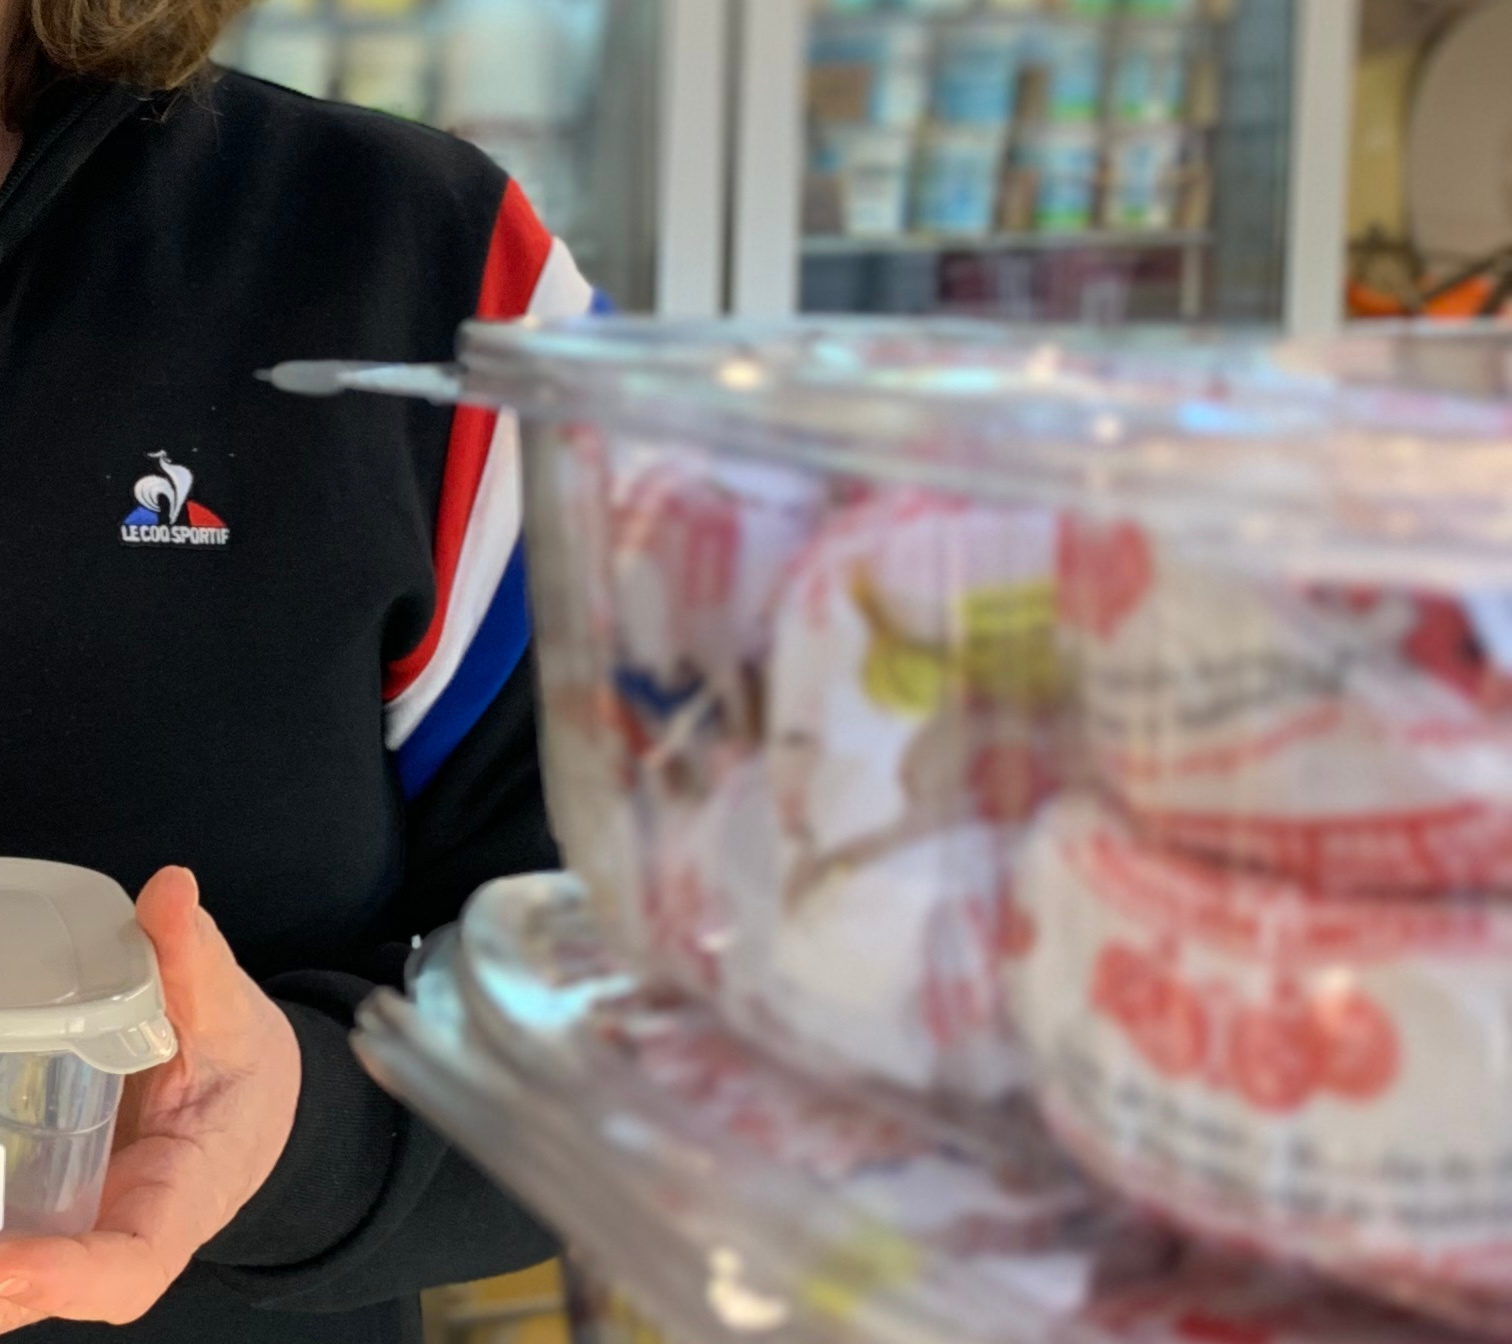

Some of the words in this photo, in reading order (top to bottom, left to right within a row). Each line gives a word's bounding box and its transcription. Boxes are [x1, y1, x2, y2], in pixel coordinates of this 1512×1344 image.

[121, 525, 139, 542] LE
[139, 525, 170, 543] COQ
[170, 526, 230, 544] SPORTIF
